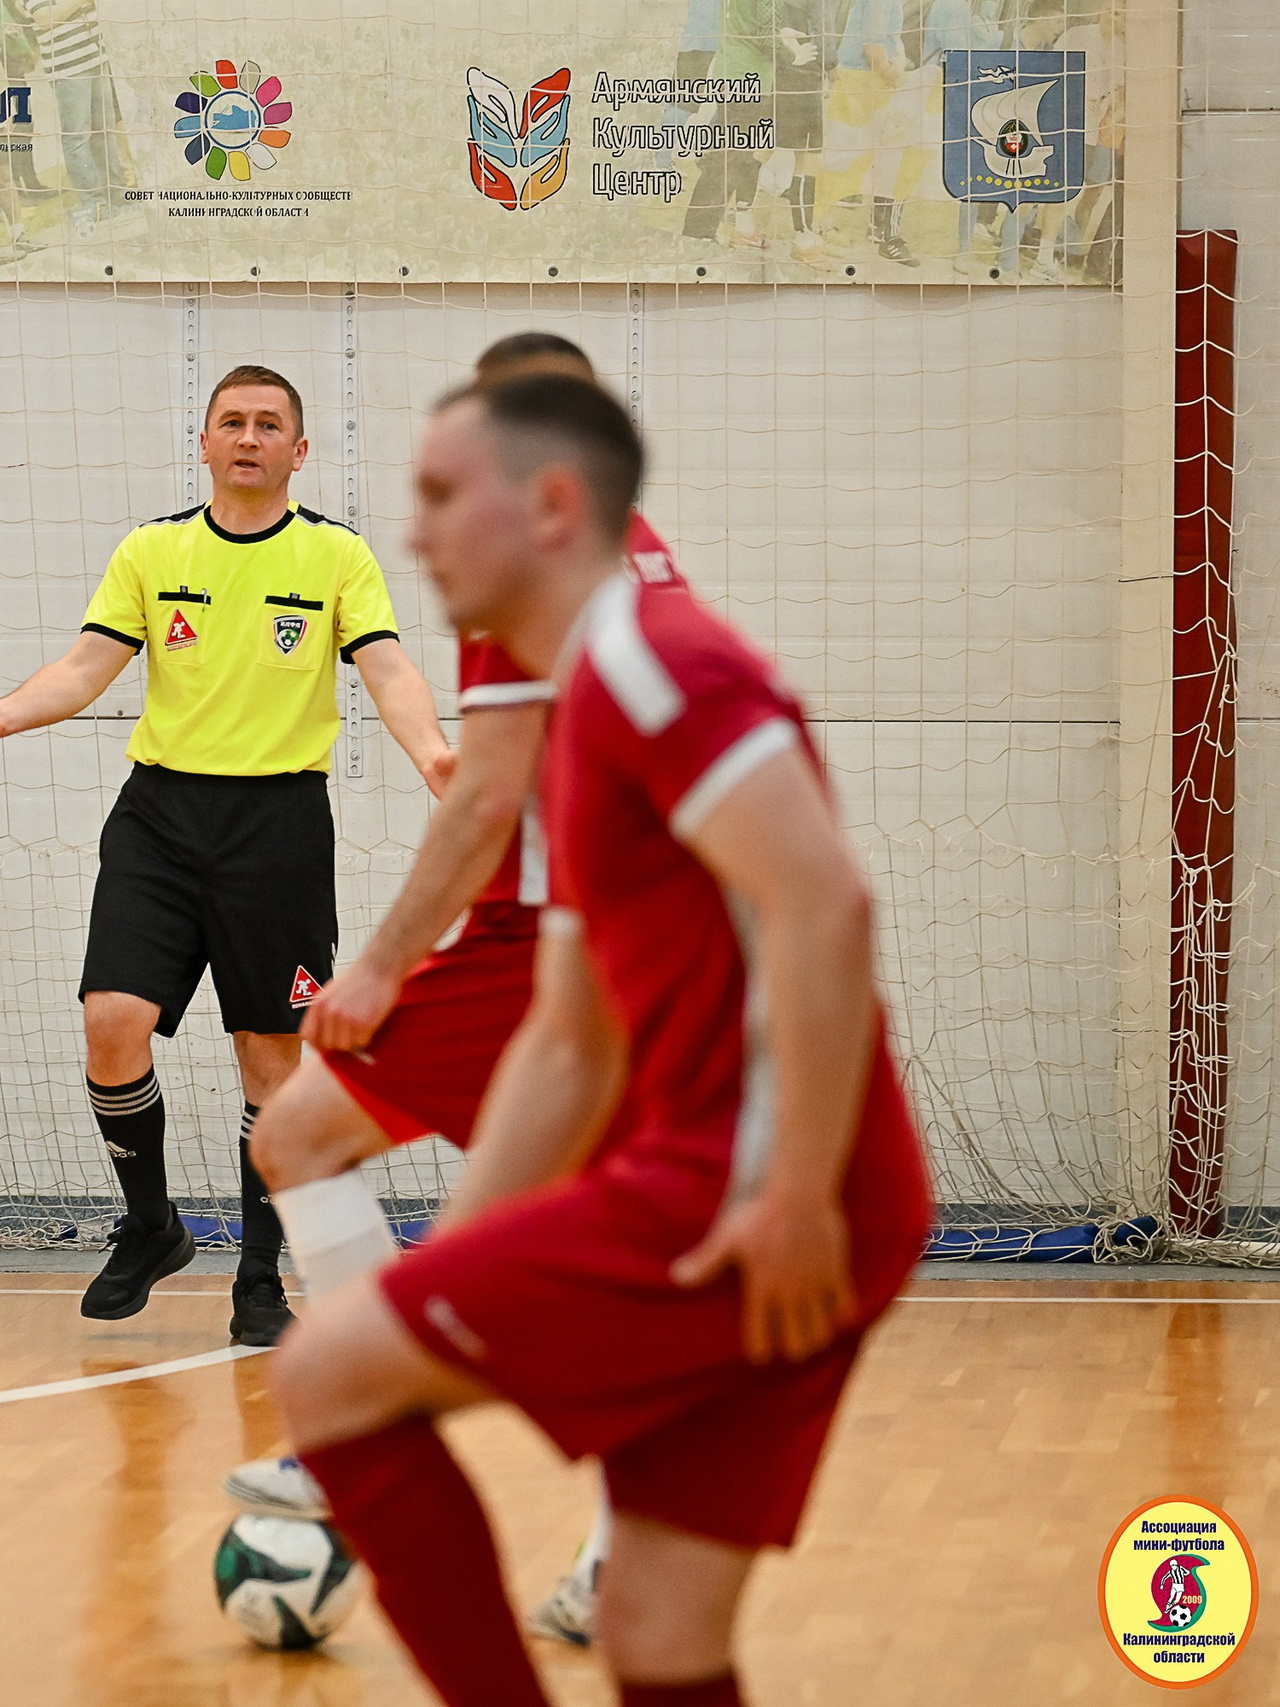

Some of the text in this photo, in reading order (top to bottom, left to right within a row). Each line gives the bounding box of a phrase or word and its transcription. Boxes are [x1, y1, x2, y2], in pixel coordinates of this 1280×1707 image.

[591, 71, 761, 111] Армянский
[592, 118, 774, 157] Культурный
[124, 191, 154, 200] СОВЕТ
[592, 163, 682, 203] Центр
